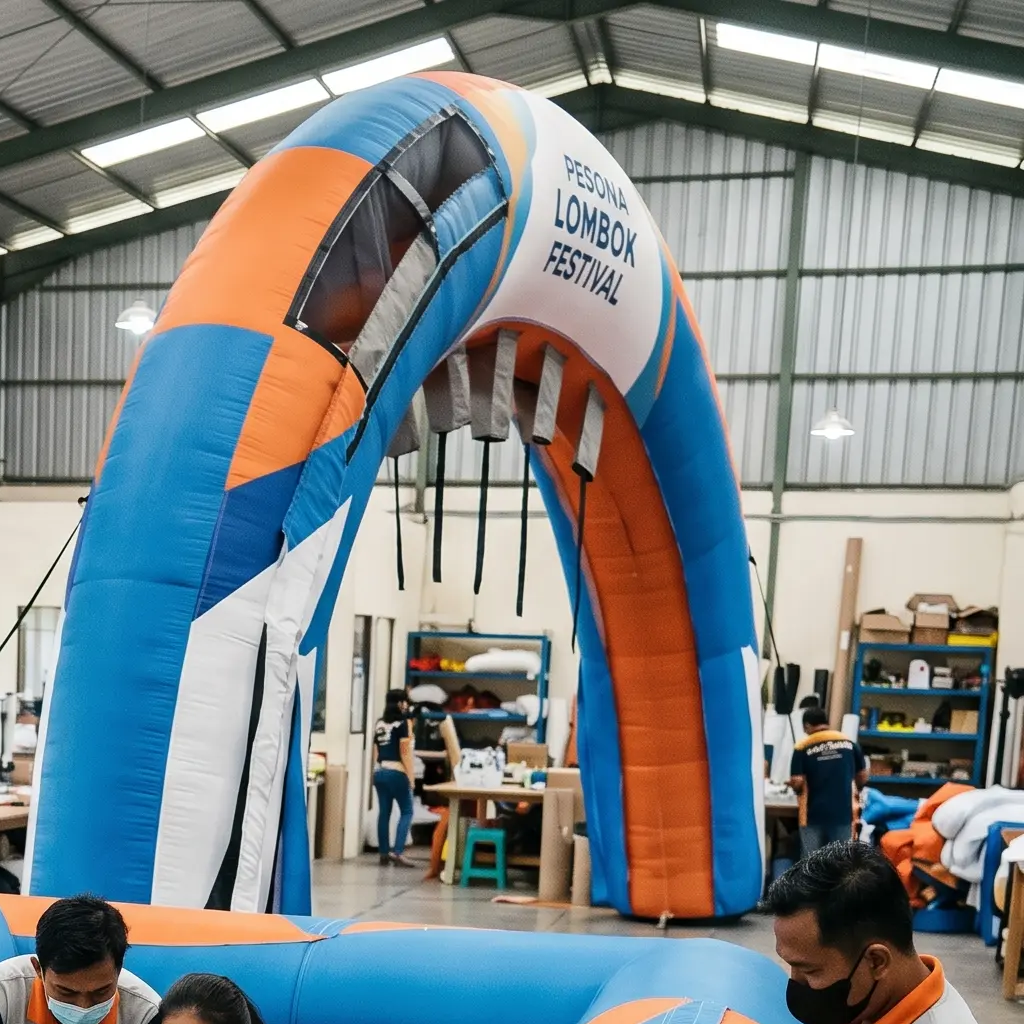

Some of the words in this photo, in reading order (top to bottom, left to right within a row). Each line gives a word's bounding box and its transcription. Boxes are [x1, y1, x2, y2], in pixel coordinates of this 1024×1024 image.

[564, 155, 630, 215] PESONA
[554, 188, 637, 268] LOMBOK
[543, 240, 624, 306] FESTIVAL
